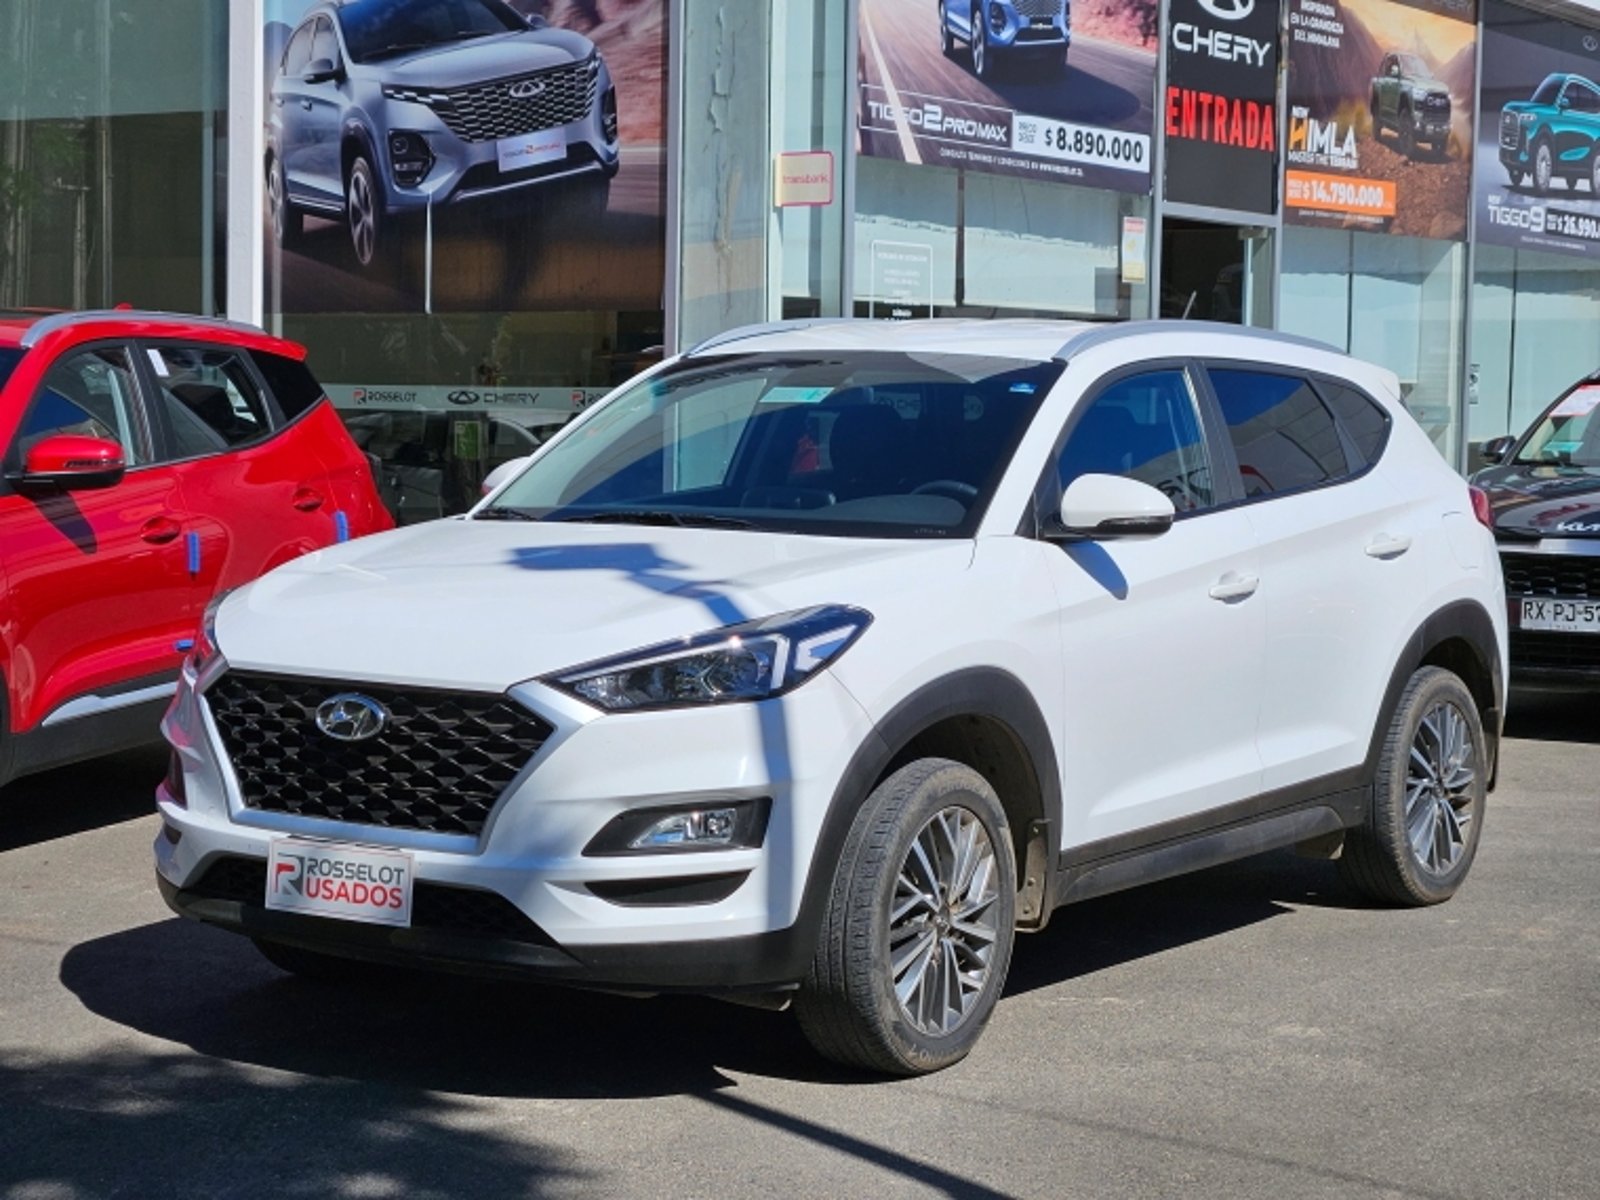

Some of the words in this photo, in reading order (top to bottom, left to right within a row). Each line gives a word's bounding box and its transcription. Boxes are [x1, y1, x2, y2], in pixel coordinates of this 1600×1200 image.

[1172, 22, 1271, 67] CHERY
[1166, 86, 1274, 152] ENTRADA
[1045, 127, 1053, 147] $
[1056, 127, 1143, 163] 8.890.000
[1289, 116, 1358, 159] HIMLA
[1564, 215, 1600, 239] 26.990.
[306, 858, 405, 885] ROSSELOT
[306, 876, 403, 909] USADOS
